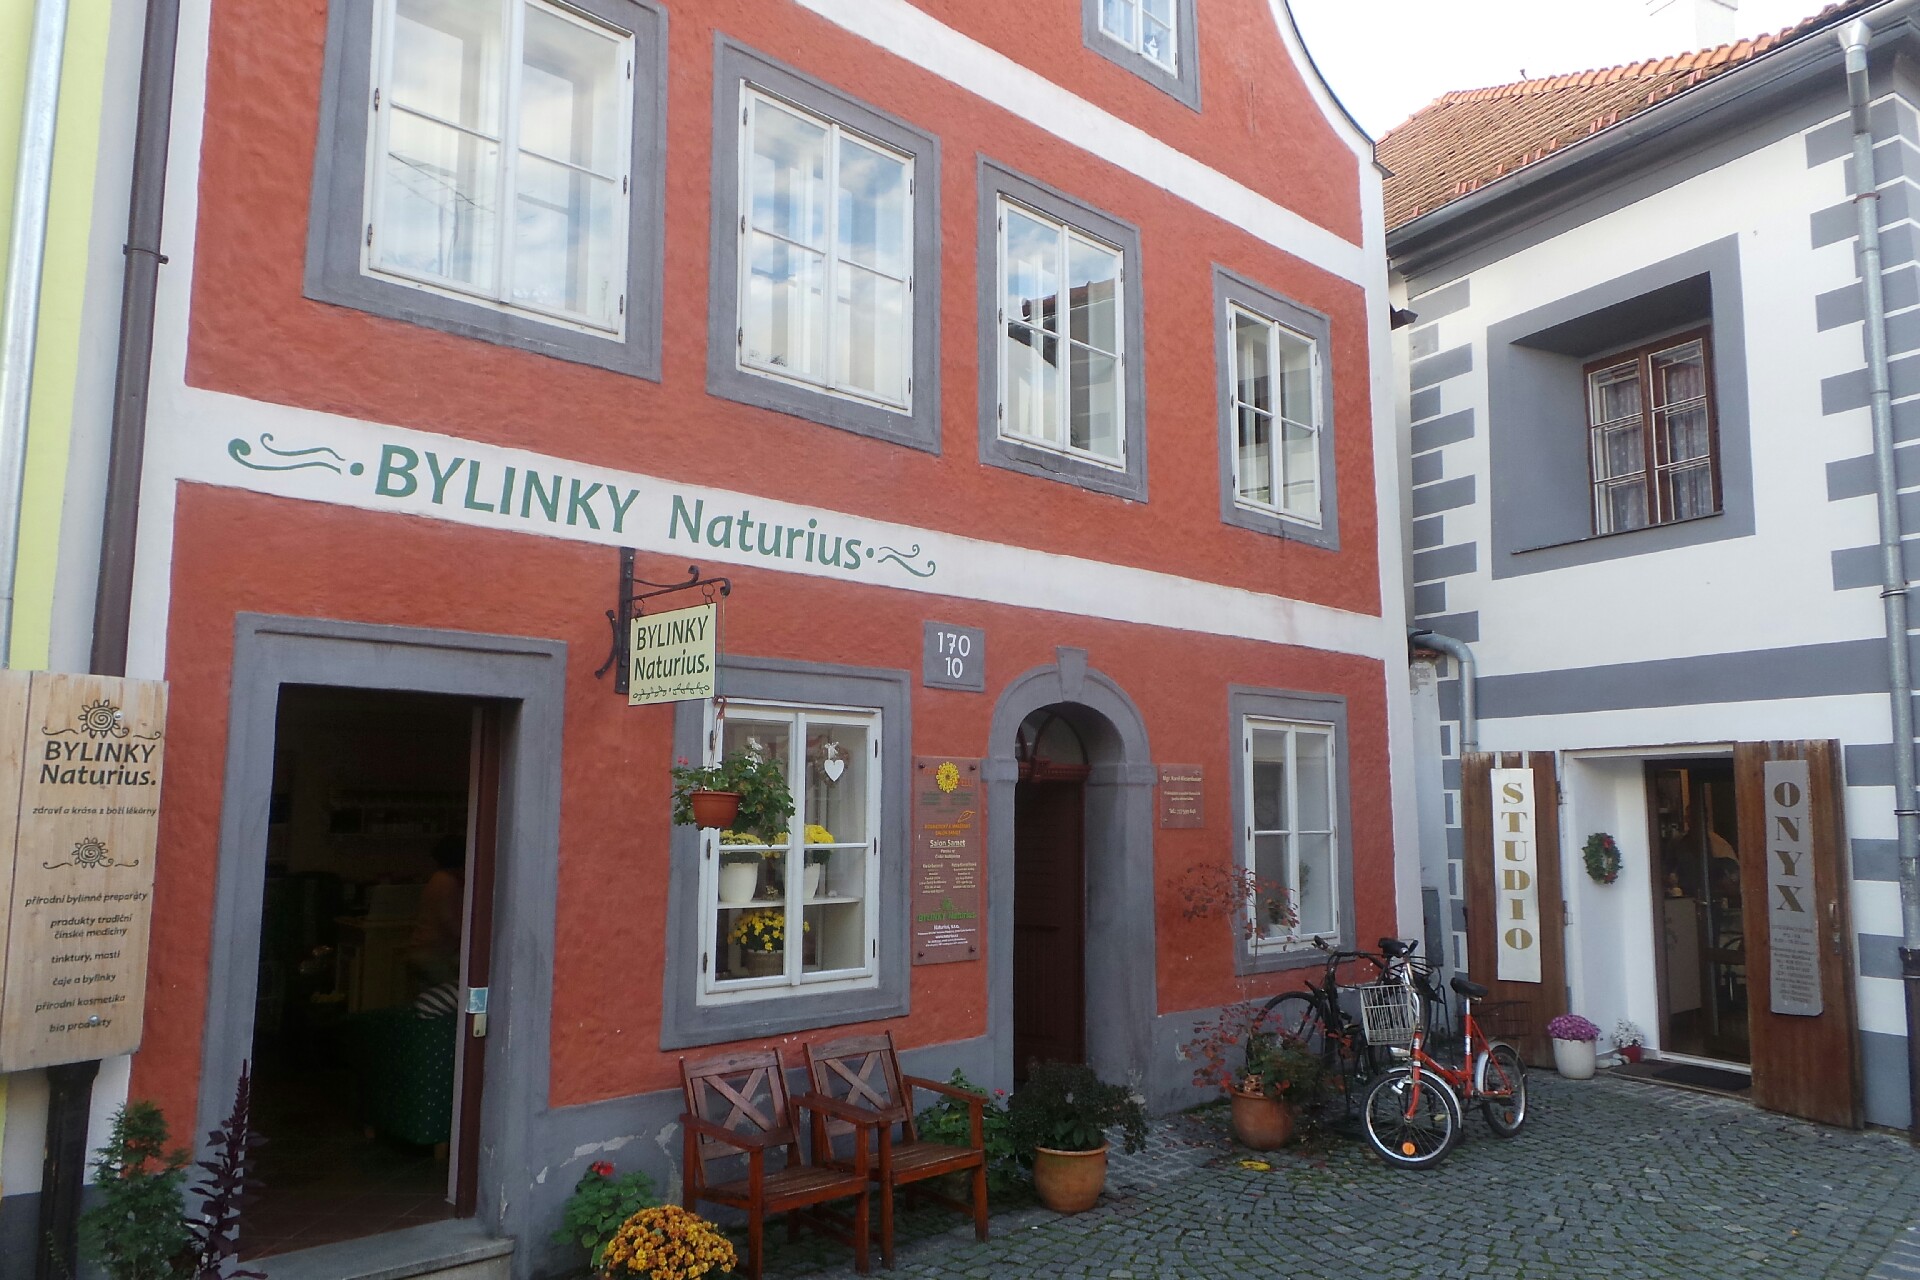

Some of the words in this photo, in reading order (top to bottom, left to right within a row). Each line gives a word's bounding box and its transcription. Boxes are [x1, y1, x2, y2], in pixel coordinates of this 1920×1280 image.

[375, 444, 640, 533] BYLINKY
[636, 615, 709, 651] BYLINKY
[937, 631, 971, 657] 170
[634, 649, 710, 681] Naturius.
[945, 656, 963, 679] 10
[45, 740, 156, 763] BYLINKY
[40, 763, 156, 786] Naturius.
[32, 806, 62, 815] zdraví
[71, 806, 97, 815] krása
[106, 805, 125, 815] boží
[126, 806, 157, 817] lékárny
[1773, 781, 1806, 913] ONYX
[1500, 782, 1533, 951] STUDIO
[25, 893, 66, 908] přírodní
[66, 894, 103, 906] bylinné
[103, 891, 148, 903] preparáty
[50, 916, 96, 929] produkty
[97, 913, 134, 924] tradiční
[54, 929, 84, 940] čínské
[86, 927, 128, 937] medicíny
[51, 954, 93, 964] tinktury,
[94, 950, 121, 961] masti
[52, 977, 72, 988] čaje
[82, 973, 117, 985] bylinky
[35, 998, 75, 1014] přírodní
[77, 995, 126, 1007] kosmetika
[49, 1023, 66, 1033] bio
